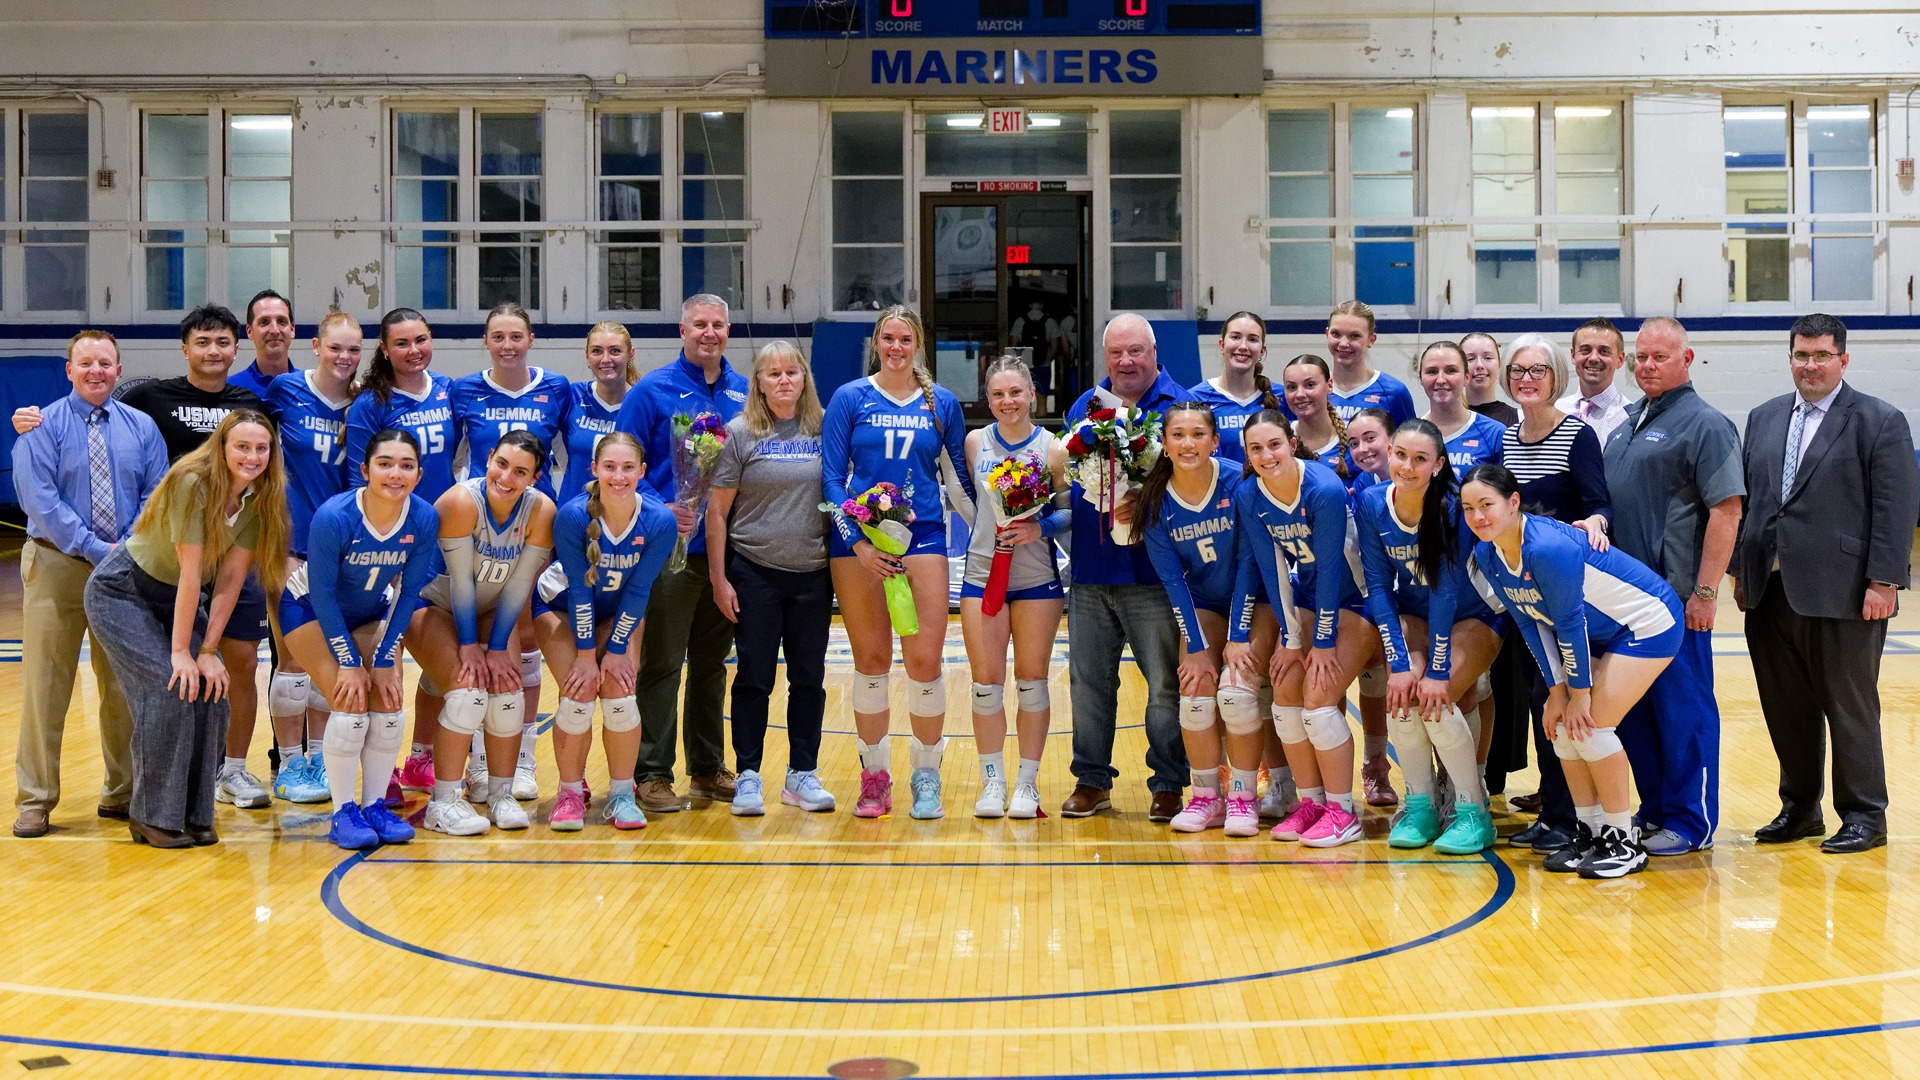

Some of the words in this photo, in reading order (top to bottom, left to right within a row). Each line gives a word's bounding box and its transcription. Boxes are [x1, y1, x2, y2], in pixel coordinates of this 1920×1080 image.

[875, 20, 922, 32] SCORE
[977, 20, 1023, 32] MATCH
[1098, 19, 1145, 31] SCORE
[871, 49, 1158, 84] MARINERS
[993, 111, 1021, 131] EXIT
[998, 182, 1034, 191] SMOKING
[1006, 246, 1030, 264] EXIT
[178, 406, 235, 422] USMM
[402, 406, 451, 427] USMMA
[485, 407, 542, 422] USMMA
[579, 415, 617, 433] USM
[871, 414, 929, 429] USMMA
[304, 415, 346, 434] USM
[416, 424, 445, 455] 15
[758, 439, 821, 456] USMMA
[884, 429, 915, 459] 17
[833, 513, 851, 541] INGS
[1172, 516, 1232, 542] USMMA
[348, 550, 407, 566] USMMA
[474, 540, 523, 560] USMMA
[1196, 536, 1218, 564] 6
[1385, 544, 1419, 560] USM
[476, 558, 511, 583] 10
[596, 552, 641, 569] SMMA
[364, 566, 381, 591] 1
[602, 570, 623, 592] 3
[1239, 593, 1256, 631] POINT
[575, 602, 593, 639] KINGS
[611, 611, 637, 644] POINT
[1316, 608, 1335, 640] POINT
[329, 635, 355, 664] KING
[1378, 623, 1399, 662] KINGS
[1432, 633, 1449, 671] POINT
[1557, 638, 1579, 677] POINT
